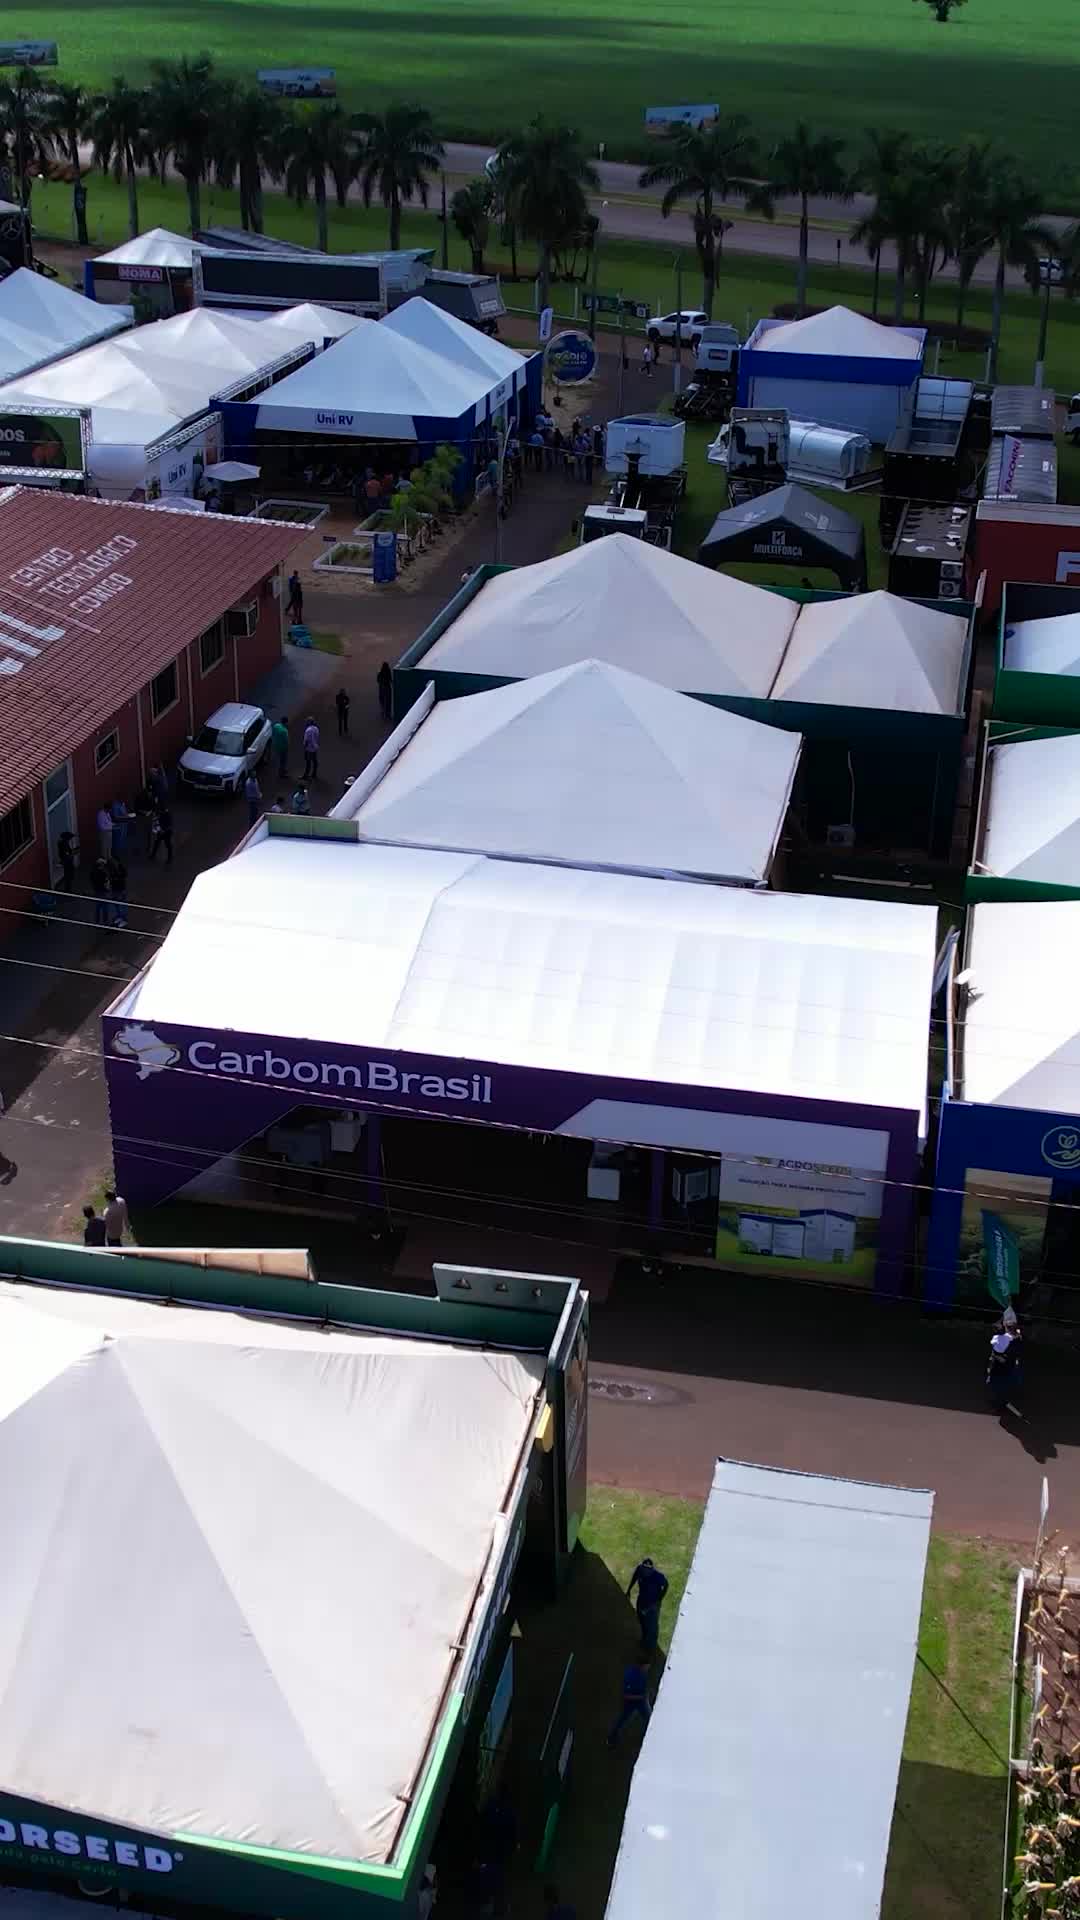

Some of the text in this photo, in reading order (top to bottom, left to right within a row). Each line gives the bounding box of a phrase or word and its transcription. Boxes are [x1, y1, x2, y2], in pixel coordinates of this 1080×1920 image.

[317, 413, 354, 426] Uni RV
[10, 547, 74, 587] CENTRO
[69, 572, 134, 614] COMIGO
